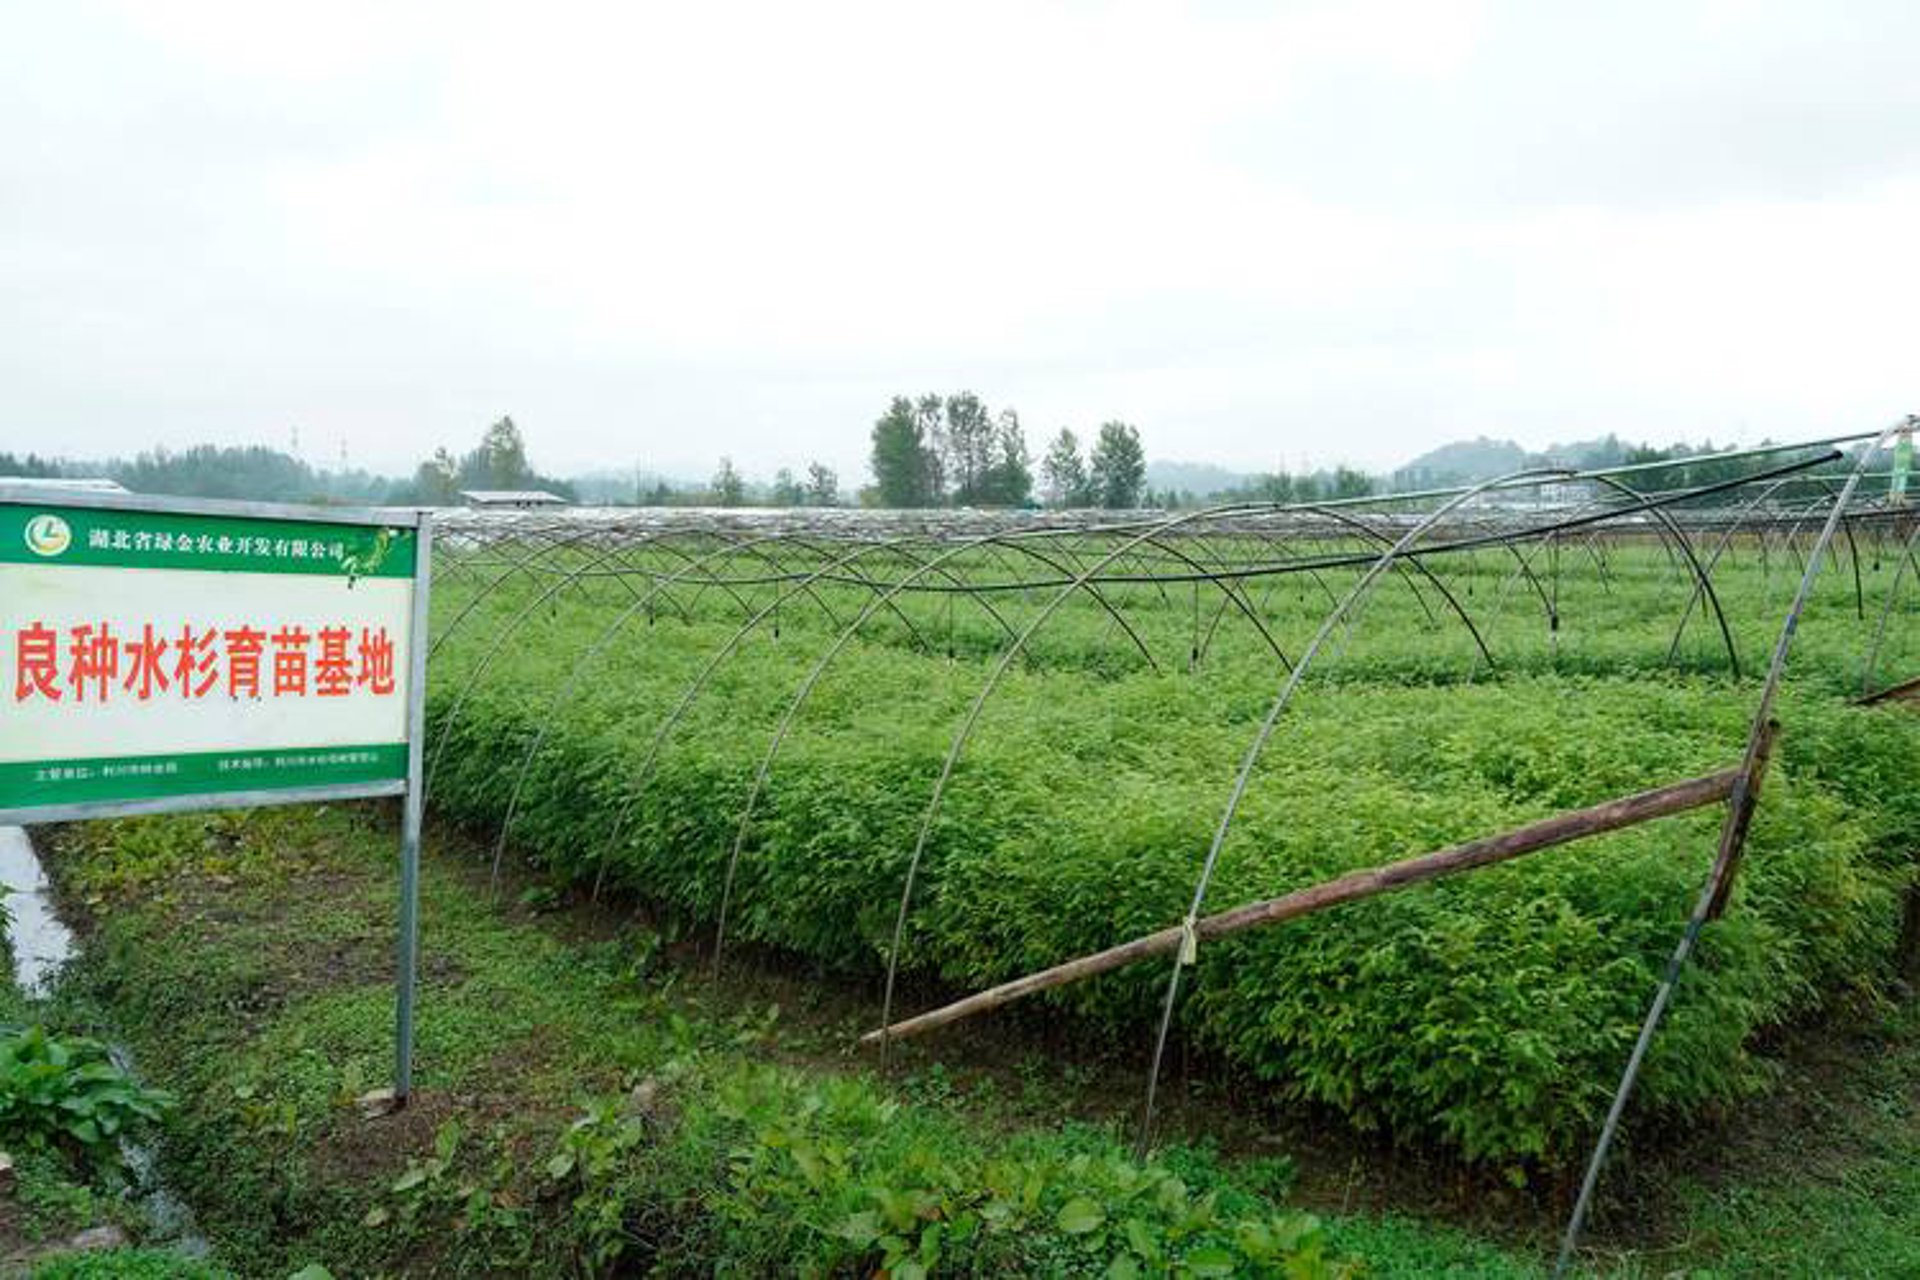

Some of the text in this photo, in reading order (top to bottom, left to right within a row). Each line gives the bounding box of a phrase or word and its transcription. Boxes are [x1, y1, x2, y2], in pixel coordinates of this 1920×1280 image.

[89, 529, 344, 559] 湖北省绿金农业开发有限公司
[15, 622, 395, 701] 良种水杉育苗基地
